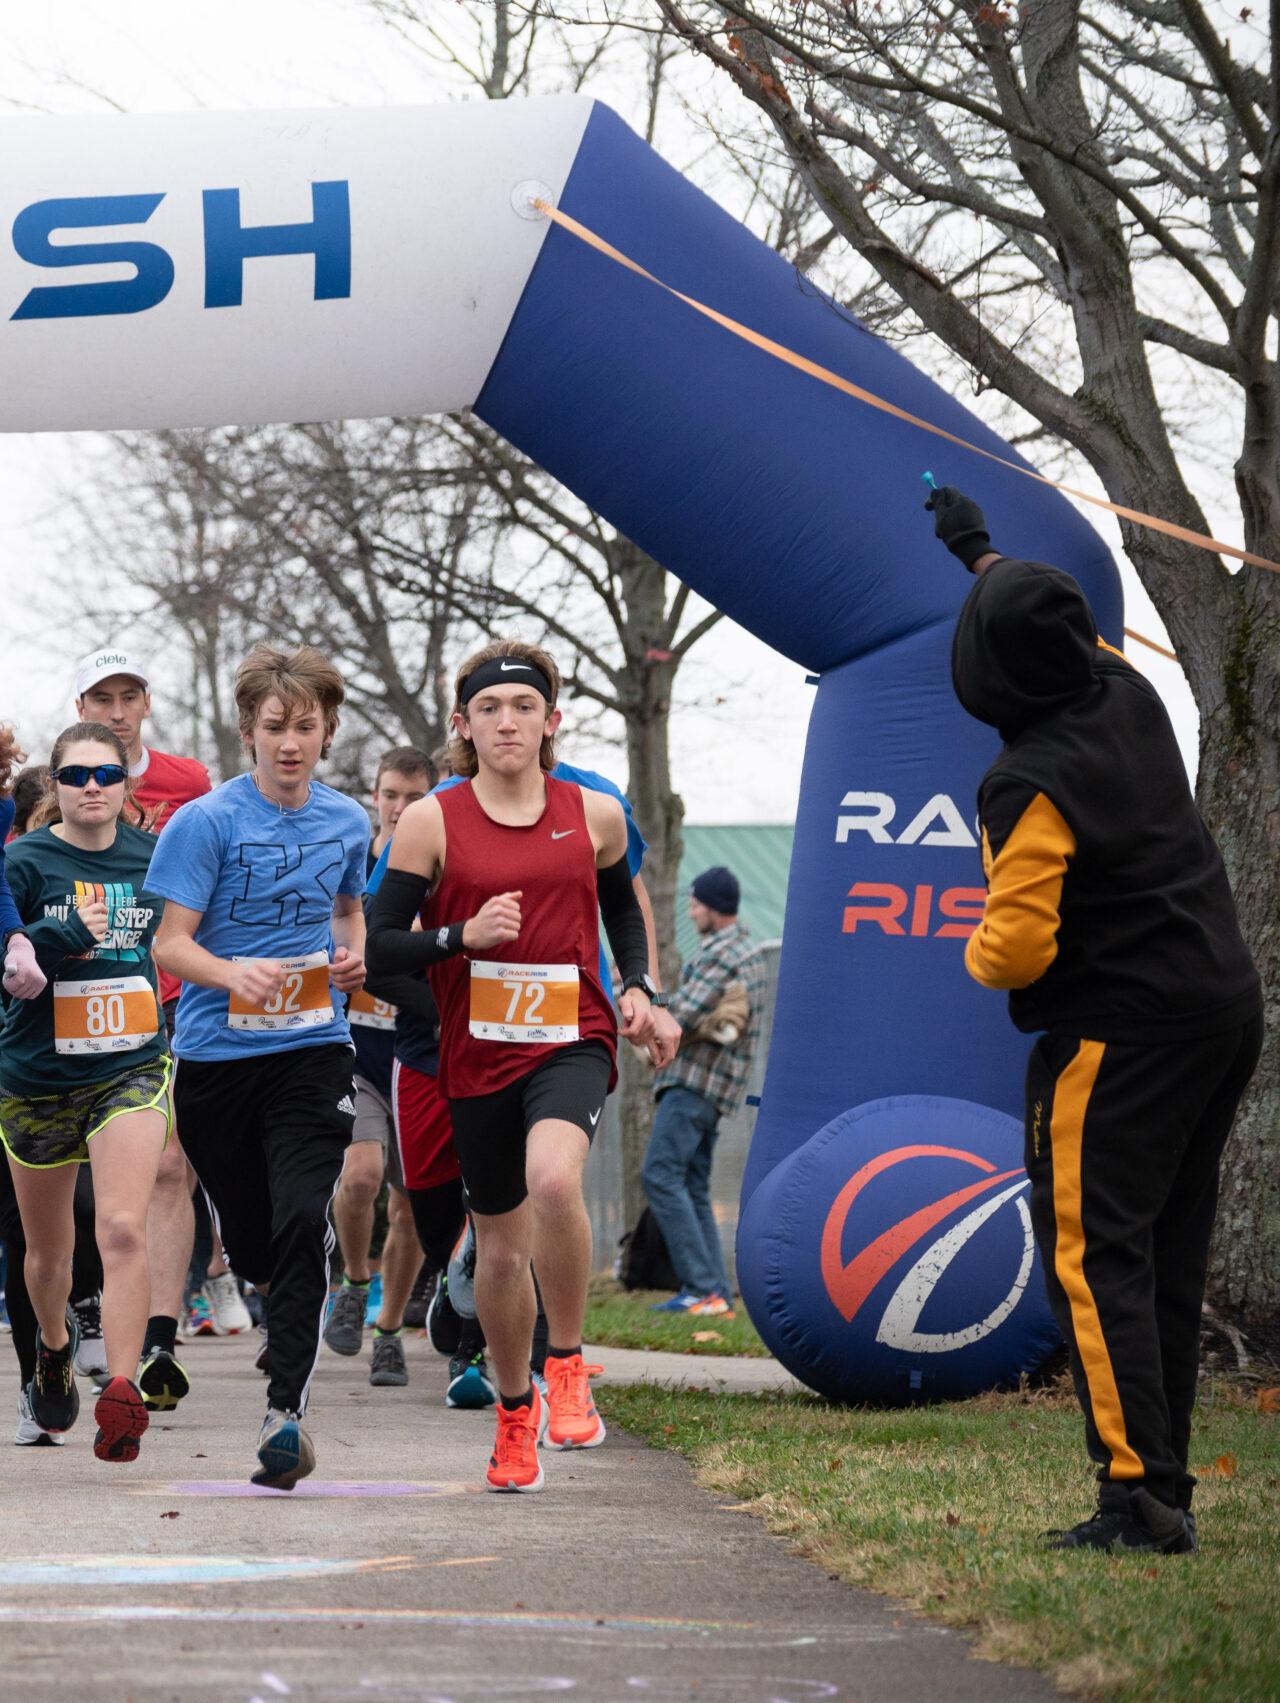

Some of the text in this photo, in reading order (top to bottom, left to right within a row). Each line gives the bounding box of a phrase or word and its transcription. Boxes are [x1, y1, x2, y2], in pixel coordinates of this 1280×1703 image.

[835, 791, 980, 848] RA
[230, 840, 345, 927] K
[115, 907, 154, 929] STEP
[86, 995, 125, 1036] 80
[503, 981, 545, 1024] 72
